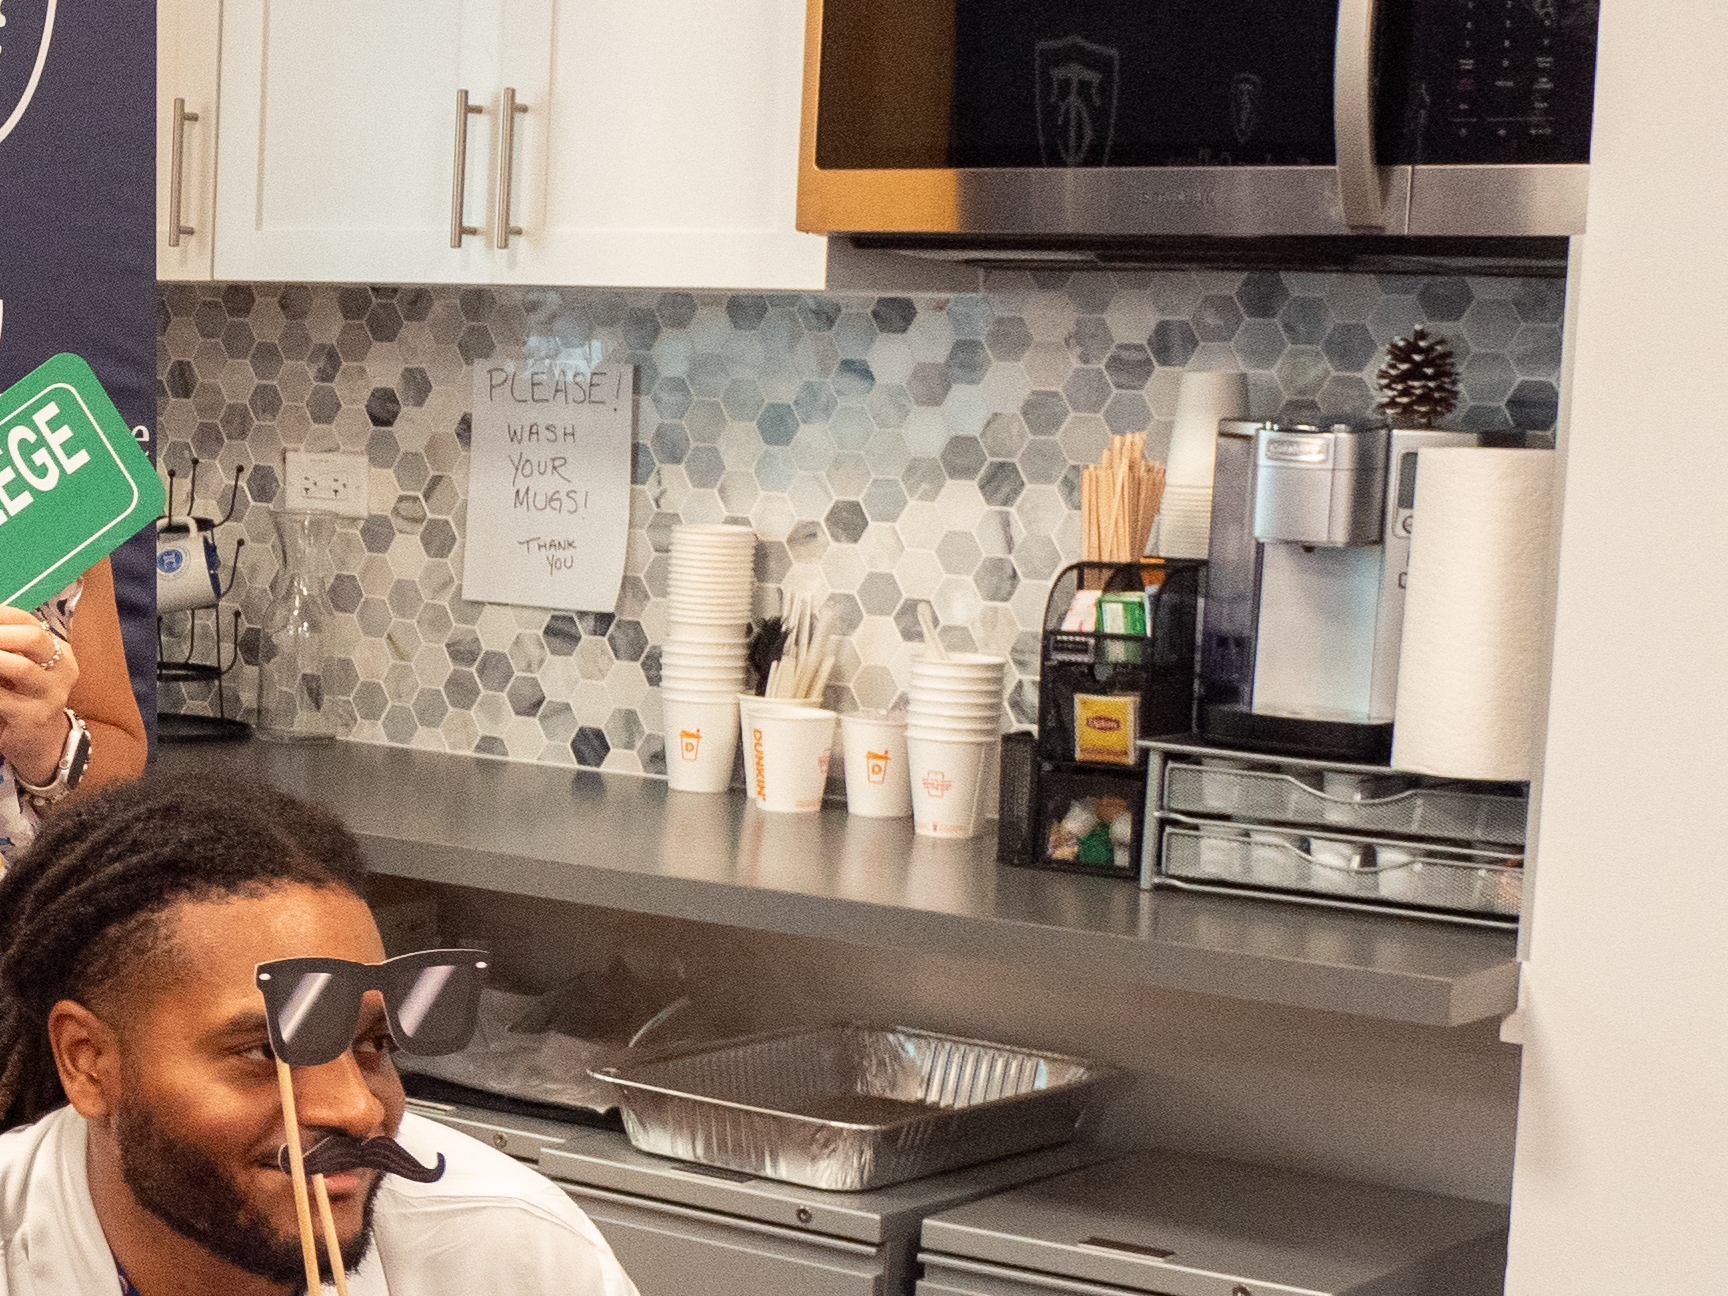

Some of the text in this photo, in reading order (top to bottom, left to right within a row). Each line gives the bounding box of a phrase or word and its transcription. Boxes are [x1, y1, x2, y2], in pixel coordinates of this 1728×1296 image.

[486, 367, 623, 412] PLEASE!
[507, 423, 576, 445] WASH
[508, 452, 572, 488] YOUR
[513, 490, 590, 520] MUGS!
[518, 537, 578, 554] THANK
[546, 554, 575, 577] YOU
